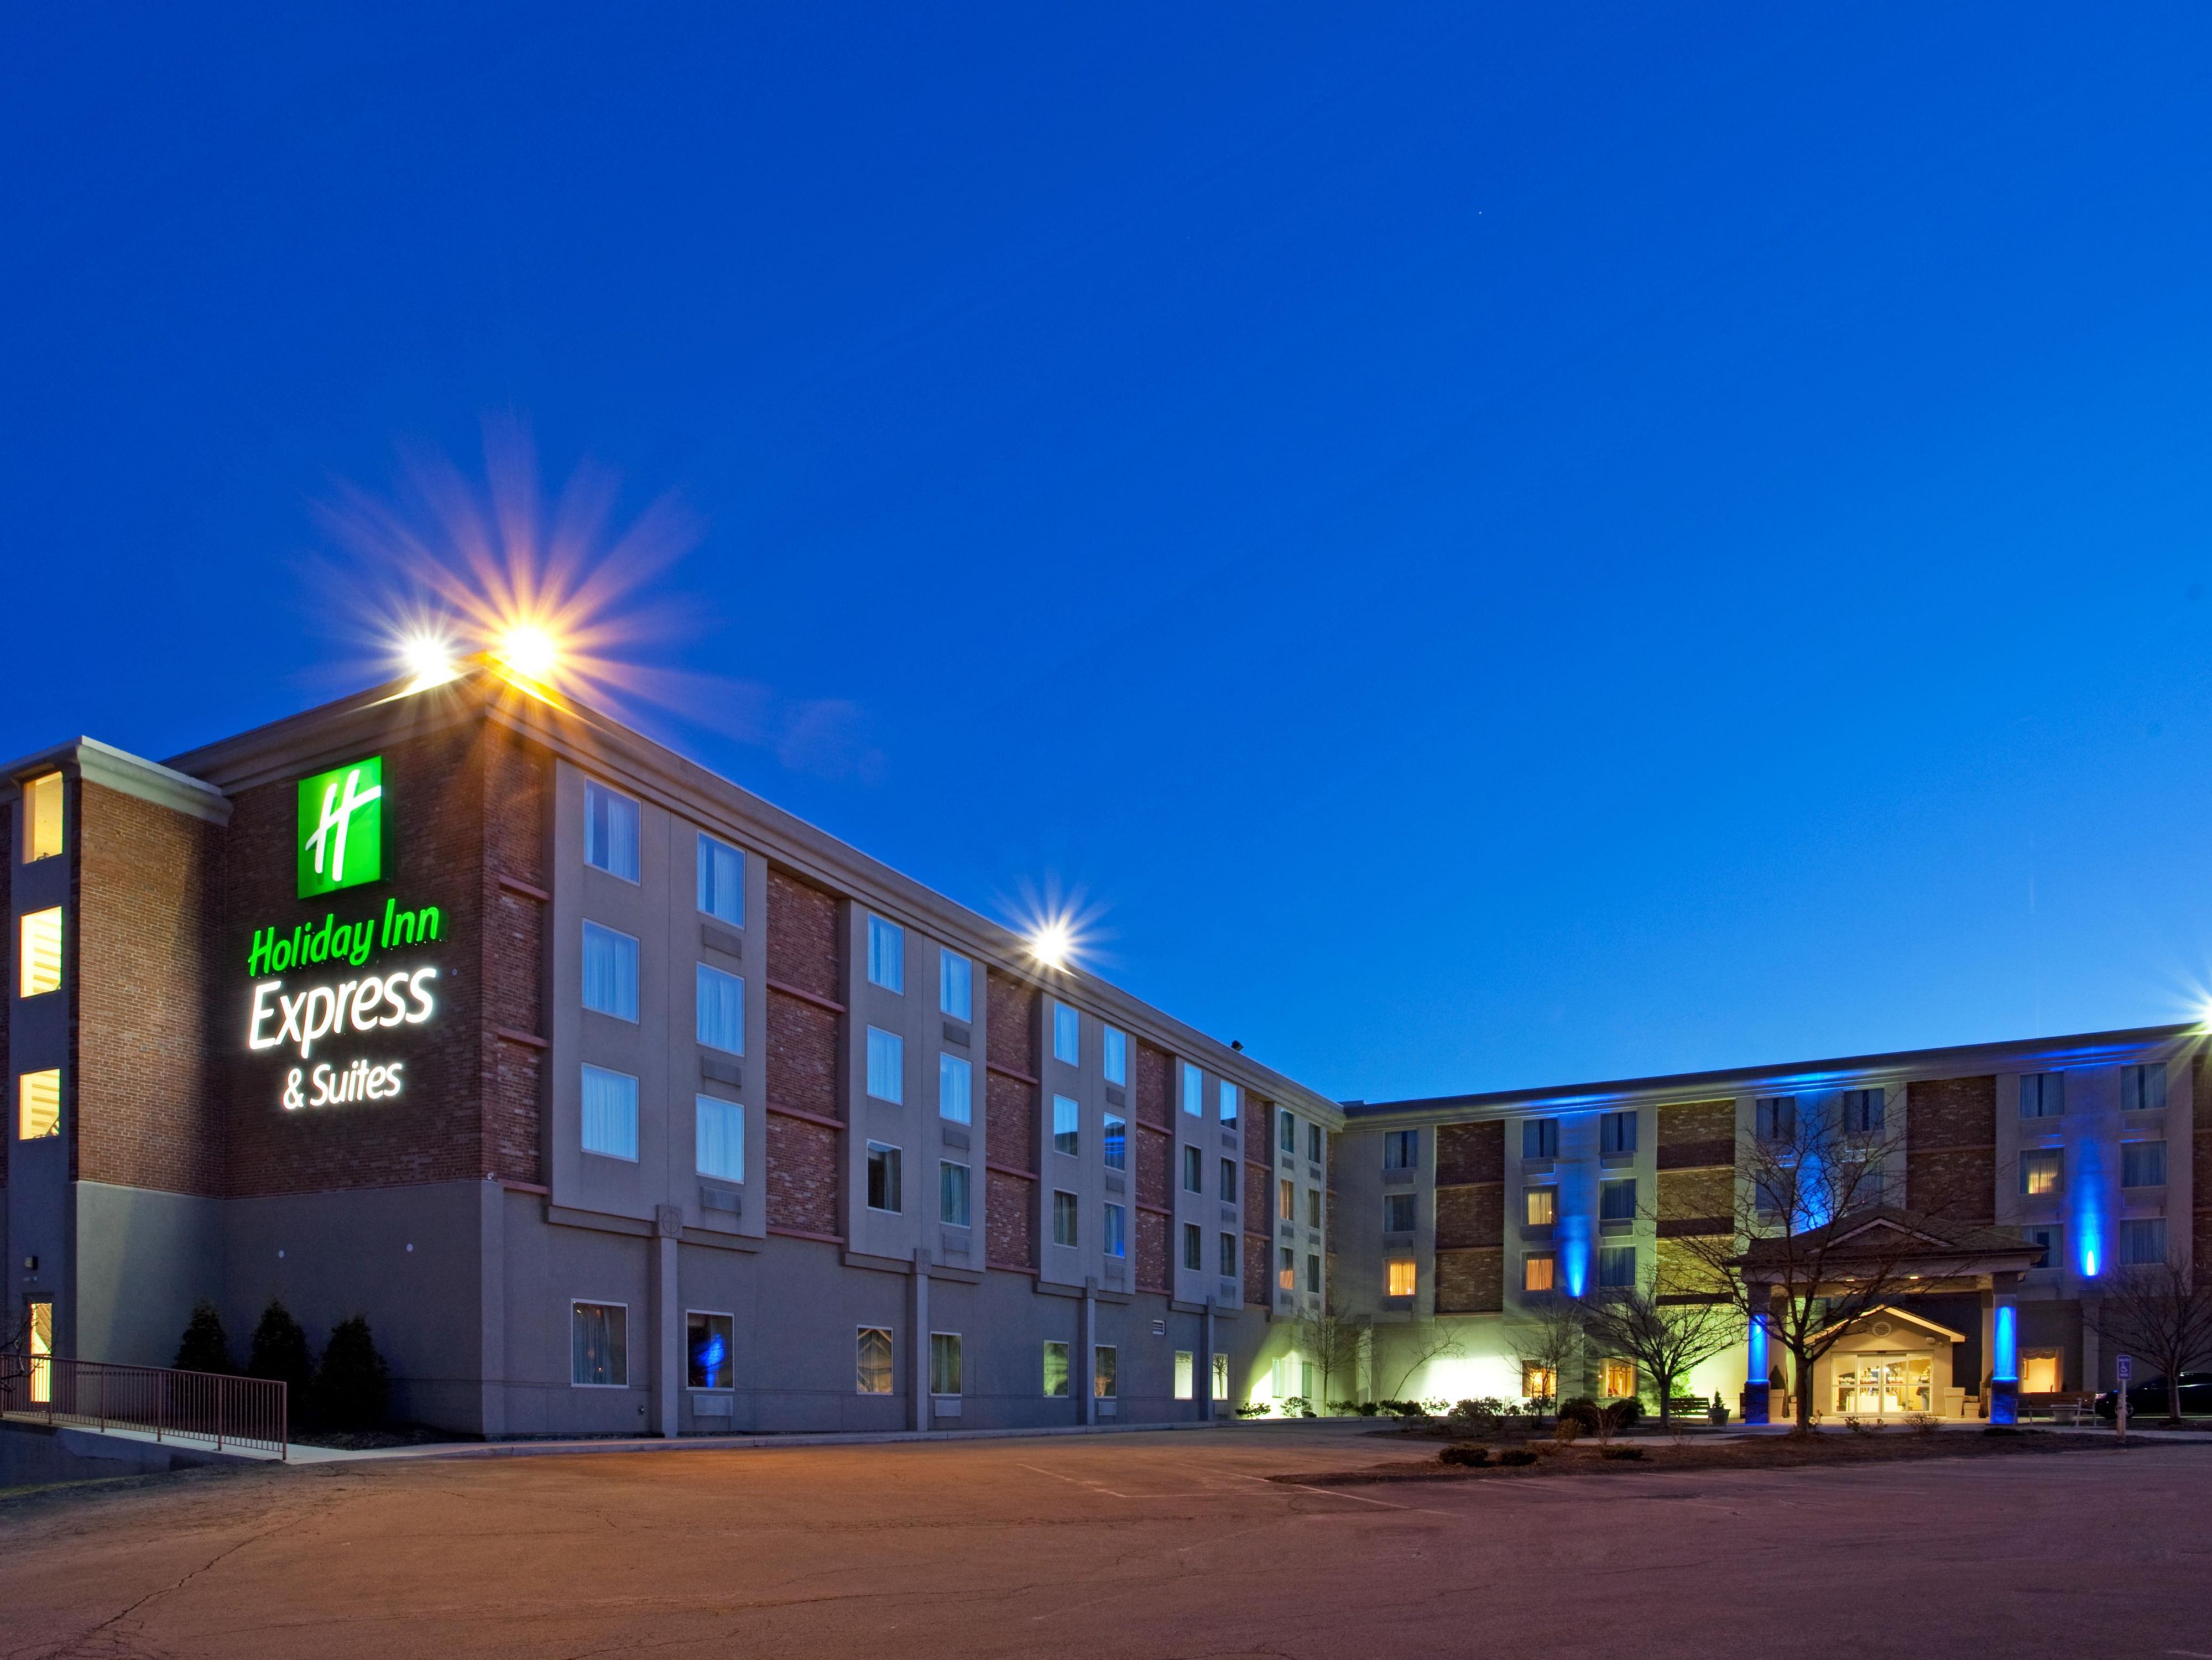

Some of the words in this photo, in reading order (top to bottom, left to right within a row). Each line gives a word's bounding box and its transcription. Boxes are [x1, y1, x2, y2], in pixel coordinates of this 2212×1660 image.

[248, 913, 374, 977] Holiday
[381, 898, 440, 948] Inn
[248, 967, 437, 1059] Express
[283, 1068, 304, 1110] &
[309, 1059, 403, 1107] Suites
